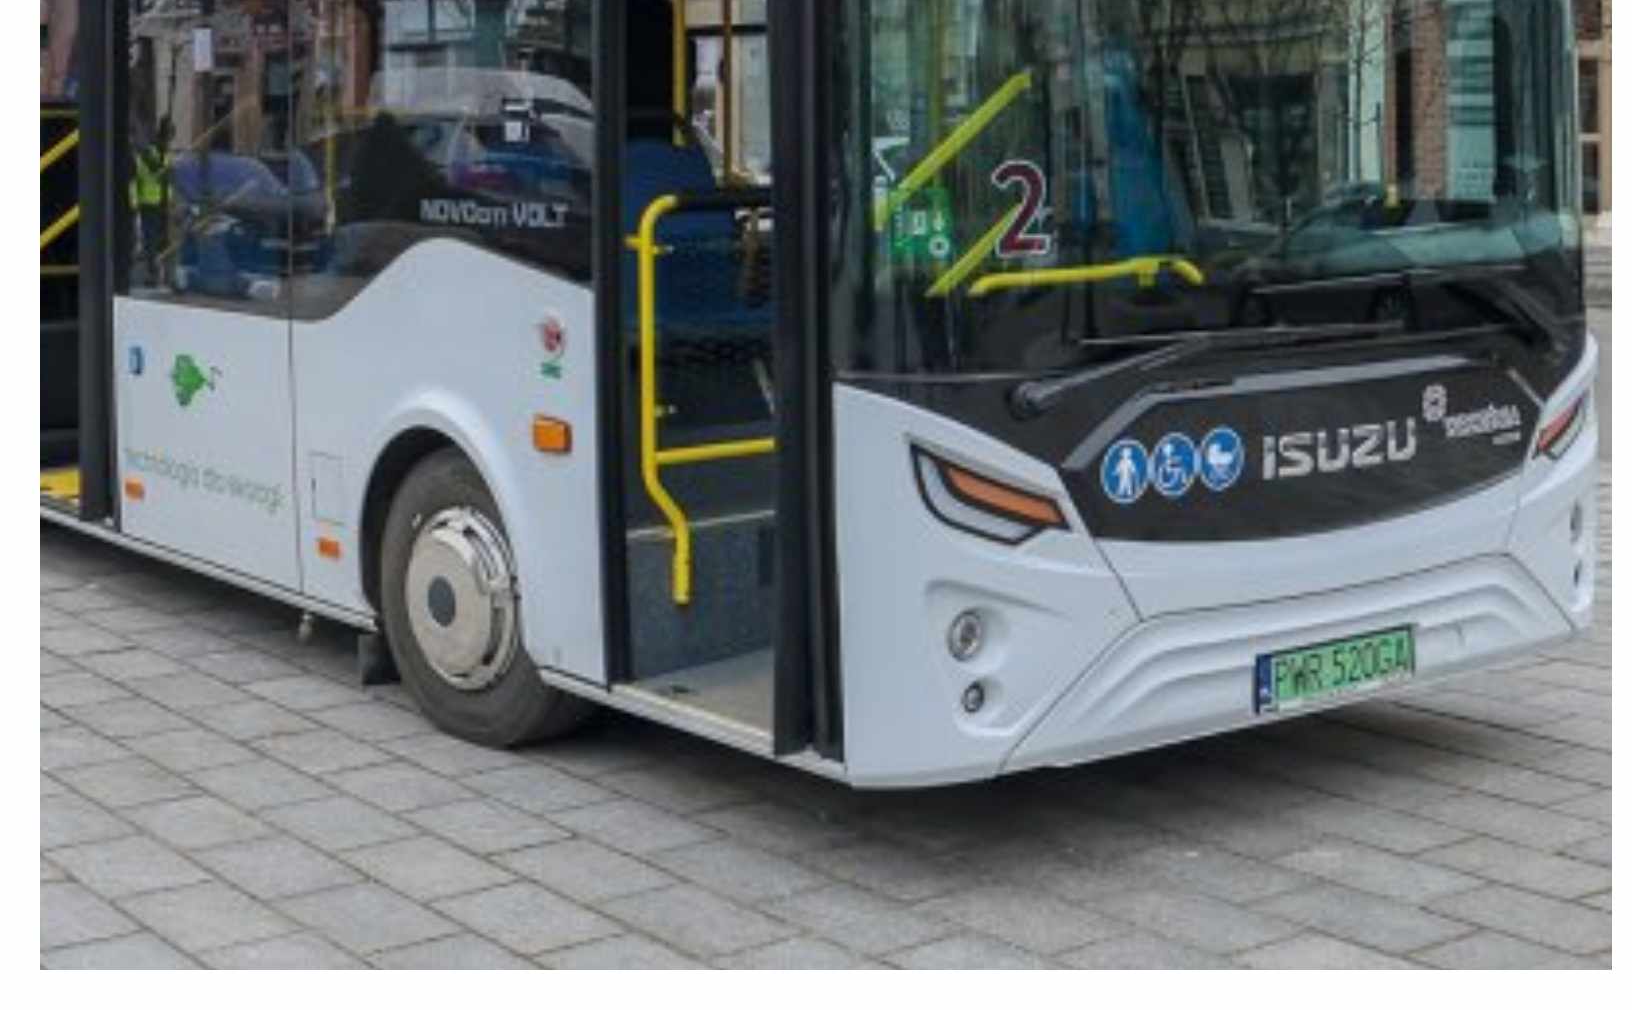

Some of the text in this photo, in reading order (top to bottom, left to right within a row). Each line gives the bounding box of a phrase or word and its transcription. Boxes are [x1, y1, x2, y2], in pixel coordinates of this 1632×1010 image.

[512, 201, 569, 228] VOLT
[991, 159, 1056, 257] 2
[1262, 417, 1417, 480] ISUZU
